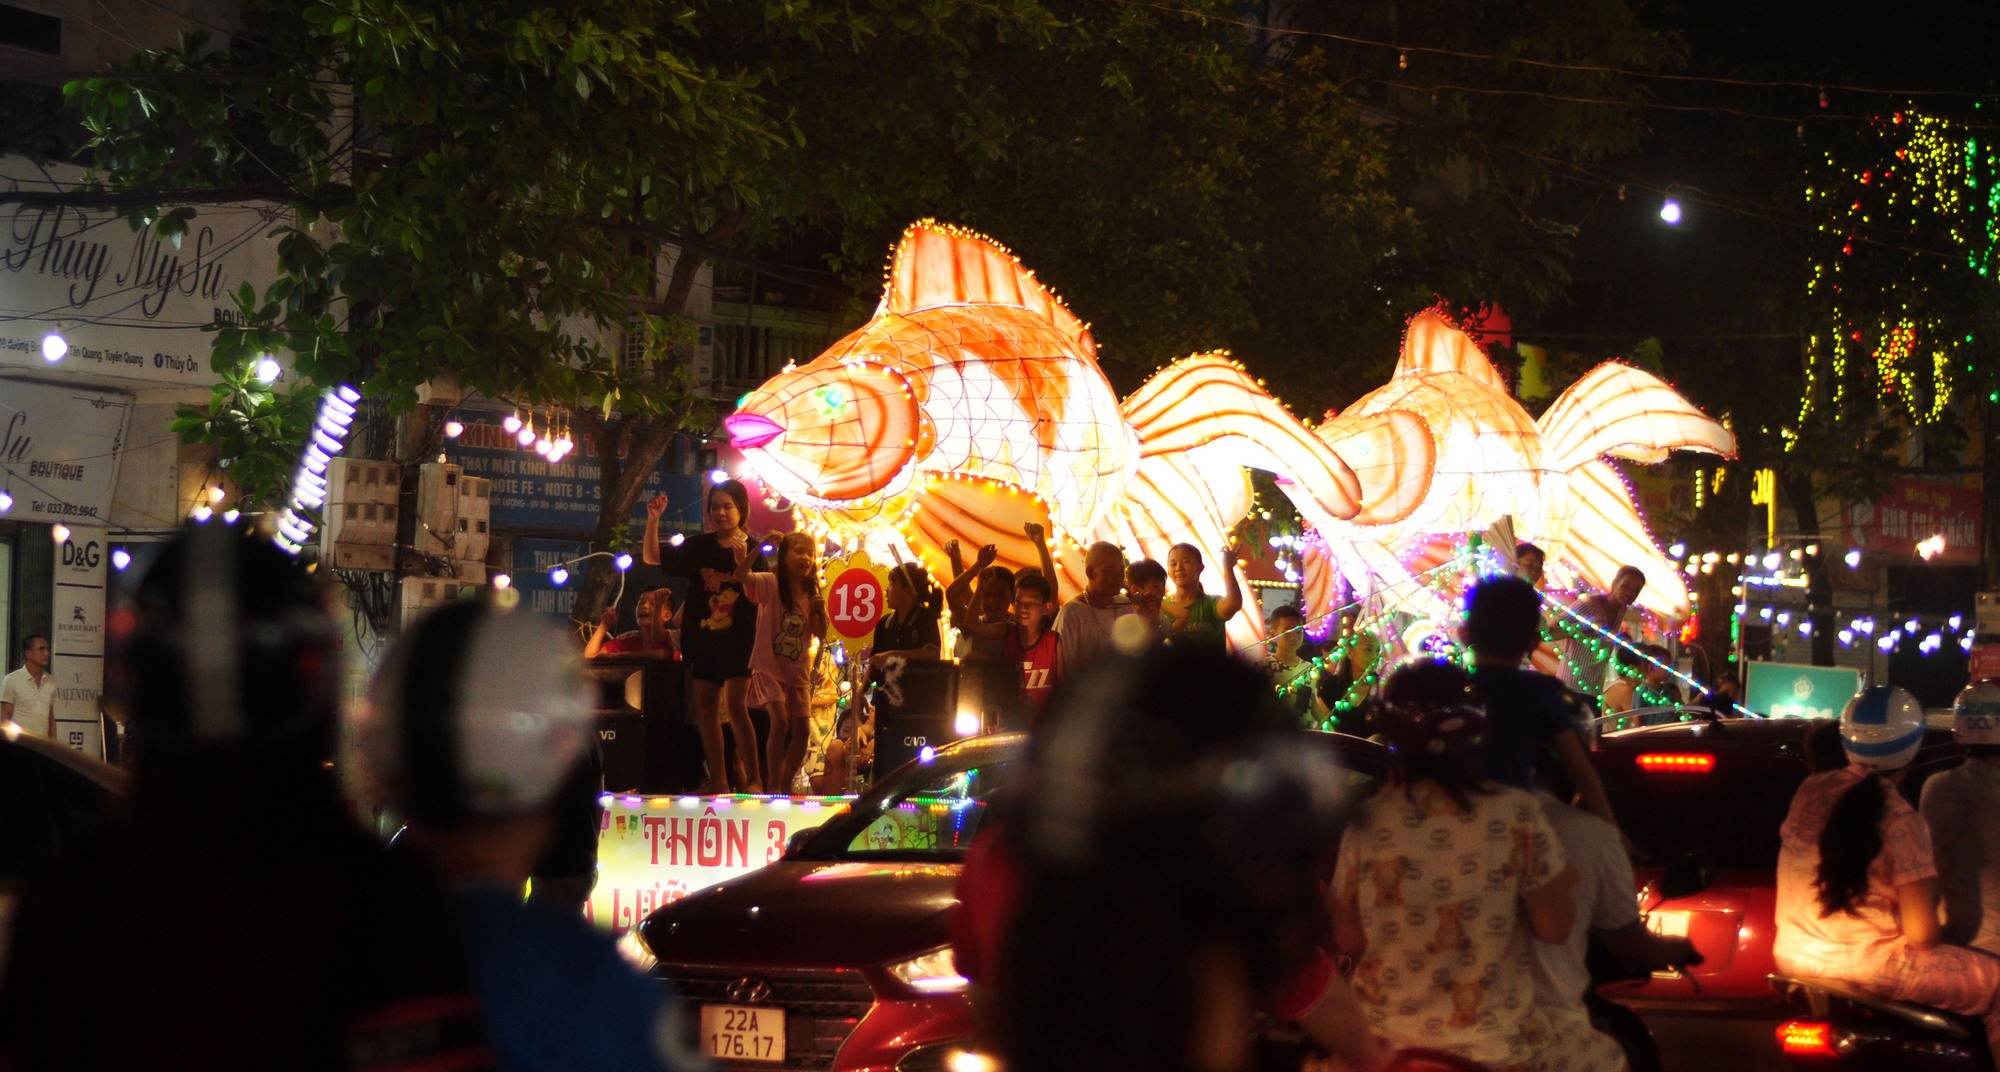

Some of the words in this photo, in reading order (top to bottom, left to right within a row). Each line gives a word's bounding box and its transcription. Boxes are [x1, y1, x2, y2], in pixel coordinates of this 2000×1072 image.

[124, 352, 144, 367] Quang
[29, 460, 85, 481] BOUTIQUE
[461, 455, 488, 472] THAY
[520, 460, 547, 477] KÍNH
[490, 478, 519, 494] NOTE
[521, 480, 534, 495] FE
[545, 482, 573, 498] NOTE
[576, 484, 583, 499] 8
[31, 501, 46, 512] Tel:
[62, 540, 100, 568] D&G
[834, 583, 876, 623] 13
[58, 624, 98, 632] BURBERRY
[56, 687, 99, 706] VALENTINO
[643, 806, 751, 869] THÔN
[766, 819, 787, 865] 3
[724, 1009, 759, 1032] 22A
[711, 1033, 774, 1058] 176.17
